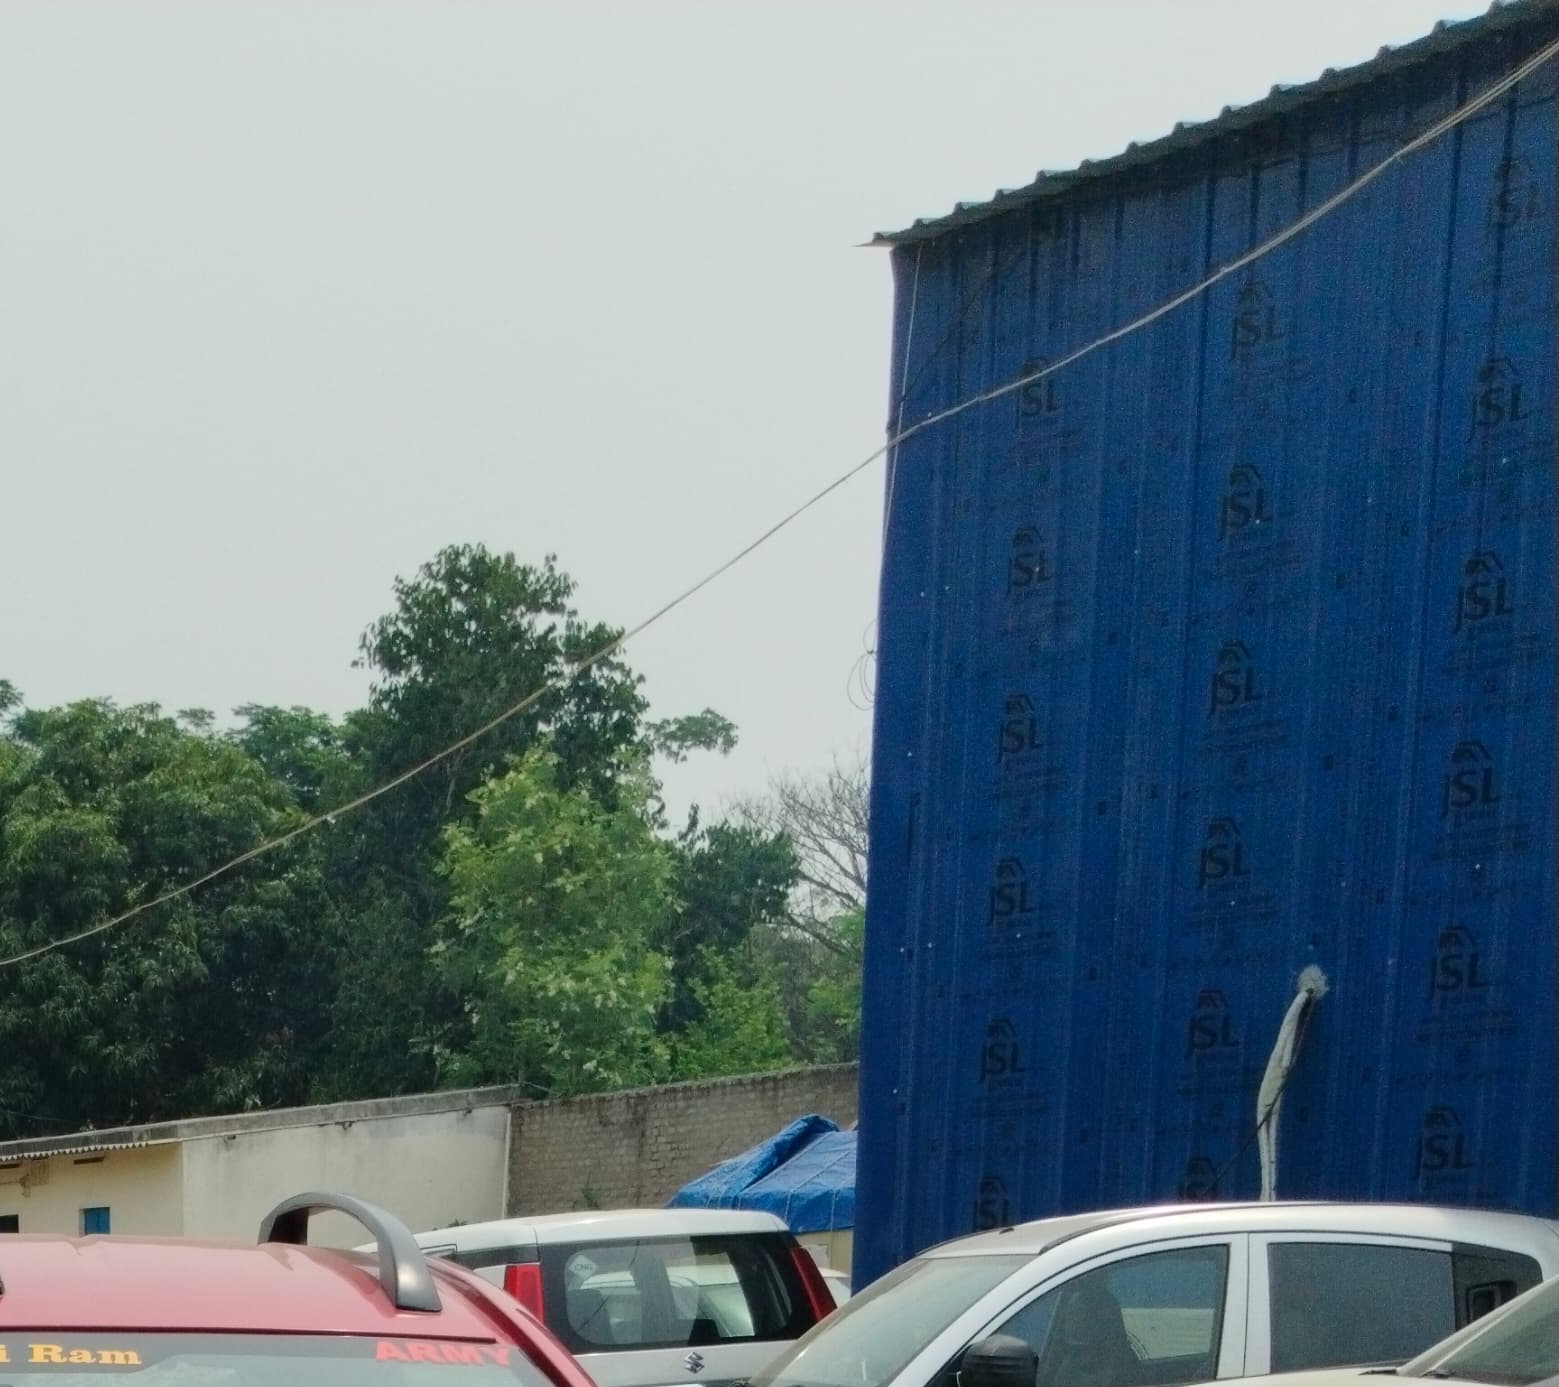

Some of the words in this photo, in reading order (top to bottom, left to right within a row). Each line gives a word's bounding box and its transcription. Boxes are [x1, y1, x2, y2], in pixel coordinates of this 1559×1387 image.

[1468, 382, 1529, 444] JSL
[1217, 488, 1274, 543] JSL
[1452, 577, 1515, 635] JSL
[1207, 667, 1263, 719] JSL
[996, 714, 1042, 764] JSL
[1439, 766, 1501, 819] JSL
[1197, 841, 1251, 891] JSL
[987, 880, 1036, 926] JSL
[1425, 952, 1490, 1003] JSL
[1185, 1009, 1240, 1060] JSL
[978, 1041, 1026, 1085] JSL
[1414, 1132, 1478, 1182] JSL
[28, 1344, 142, 1365] Ram
[375, 1341, 510, 1366] ARMY
